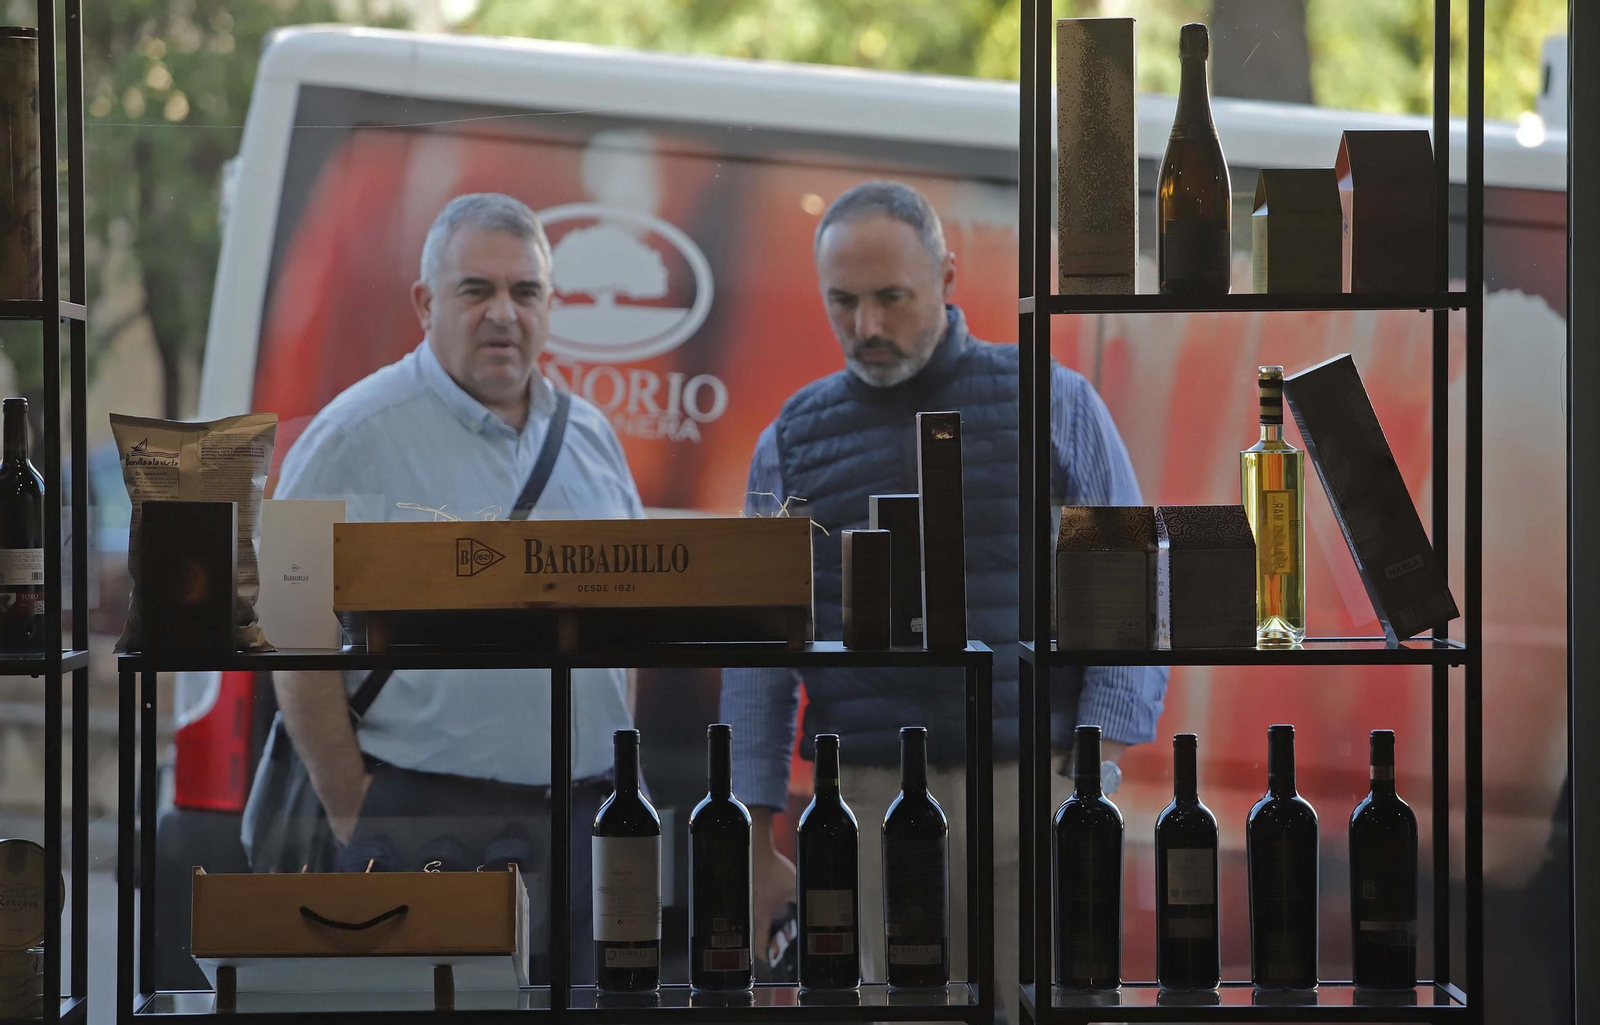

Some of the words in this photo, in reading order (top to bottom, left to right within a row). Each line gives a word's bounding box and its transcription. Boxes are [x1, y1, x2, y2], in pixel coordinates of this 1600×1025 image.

[460, 549, 469, 565] B
[476, 553, 491, 561] 1821
[523, 538, 690, 574] BARBADILLO
[1388, 558, 1420, 577] HABLA
[577, 584, 609, 592] DESDE
[614, 584, 636, 592] 1821
